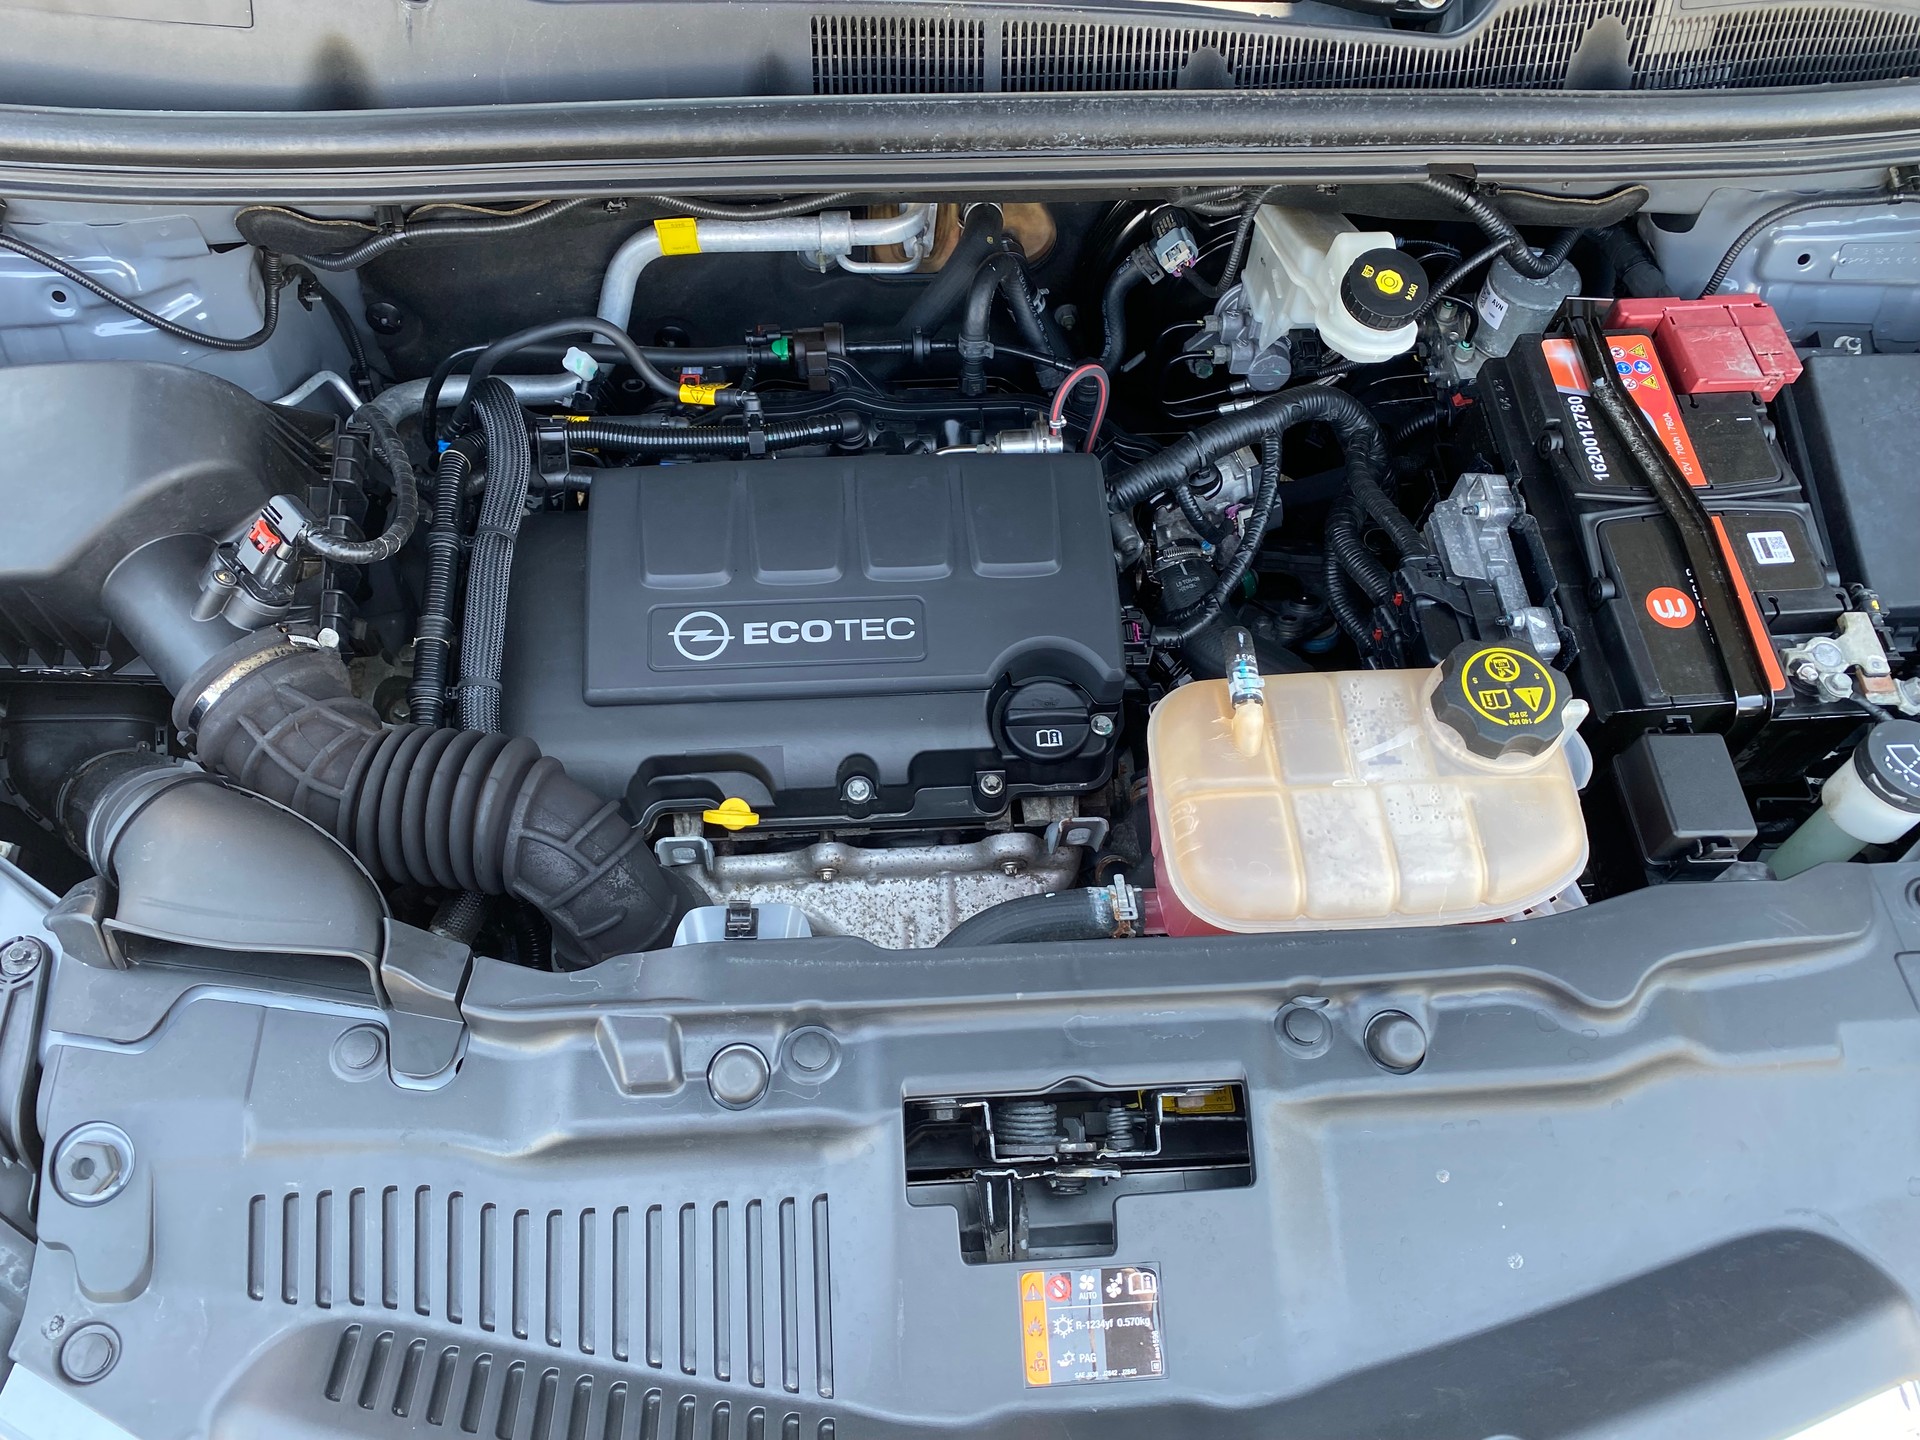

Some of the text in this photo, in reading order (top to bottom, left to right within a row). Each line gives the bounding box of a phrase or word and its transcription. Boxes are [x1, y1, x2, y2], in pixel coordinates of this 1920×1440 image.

[1662, 411, 1676, 430] 760A
[1567, 396, 1610, 481] 1620012780
[1673, 436, 1686, 455] 70Ah
[1681, 461, 1693, 475] 12V
[743, 617, 916, 645] ECOTEC
[1078, 1292, 1097, 1300] AUTO
[1075, 1317, 1151, 1330] R-1234yf 0.570kg
[1079, 1353, 1097, 1363] PAG
